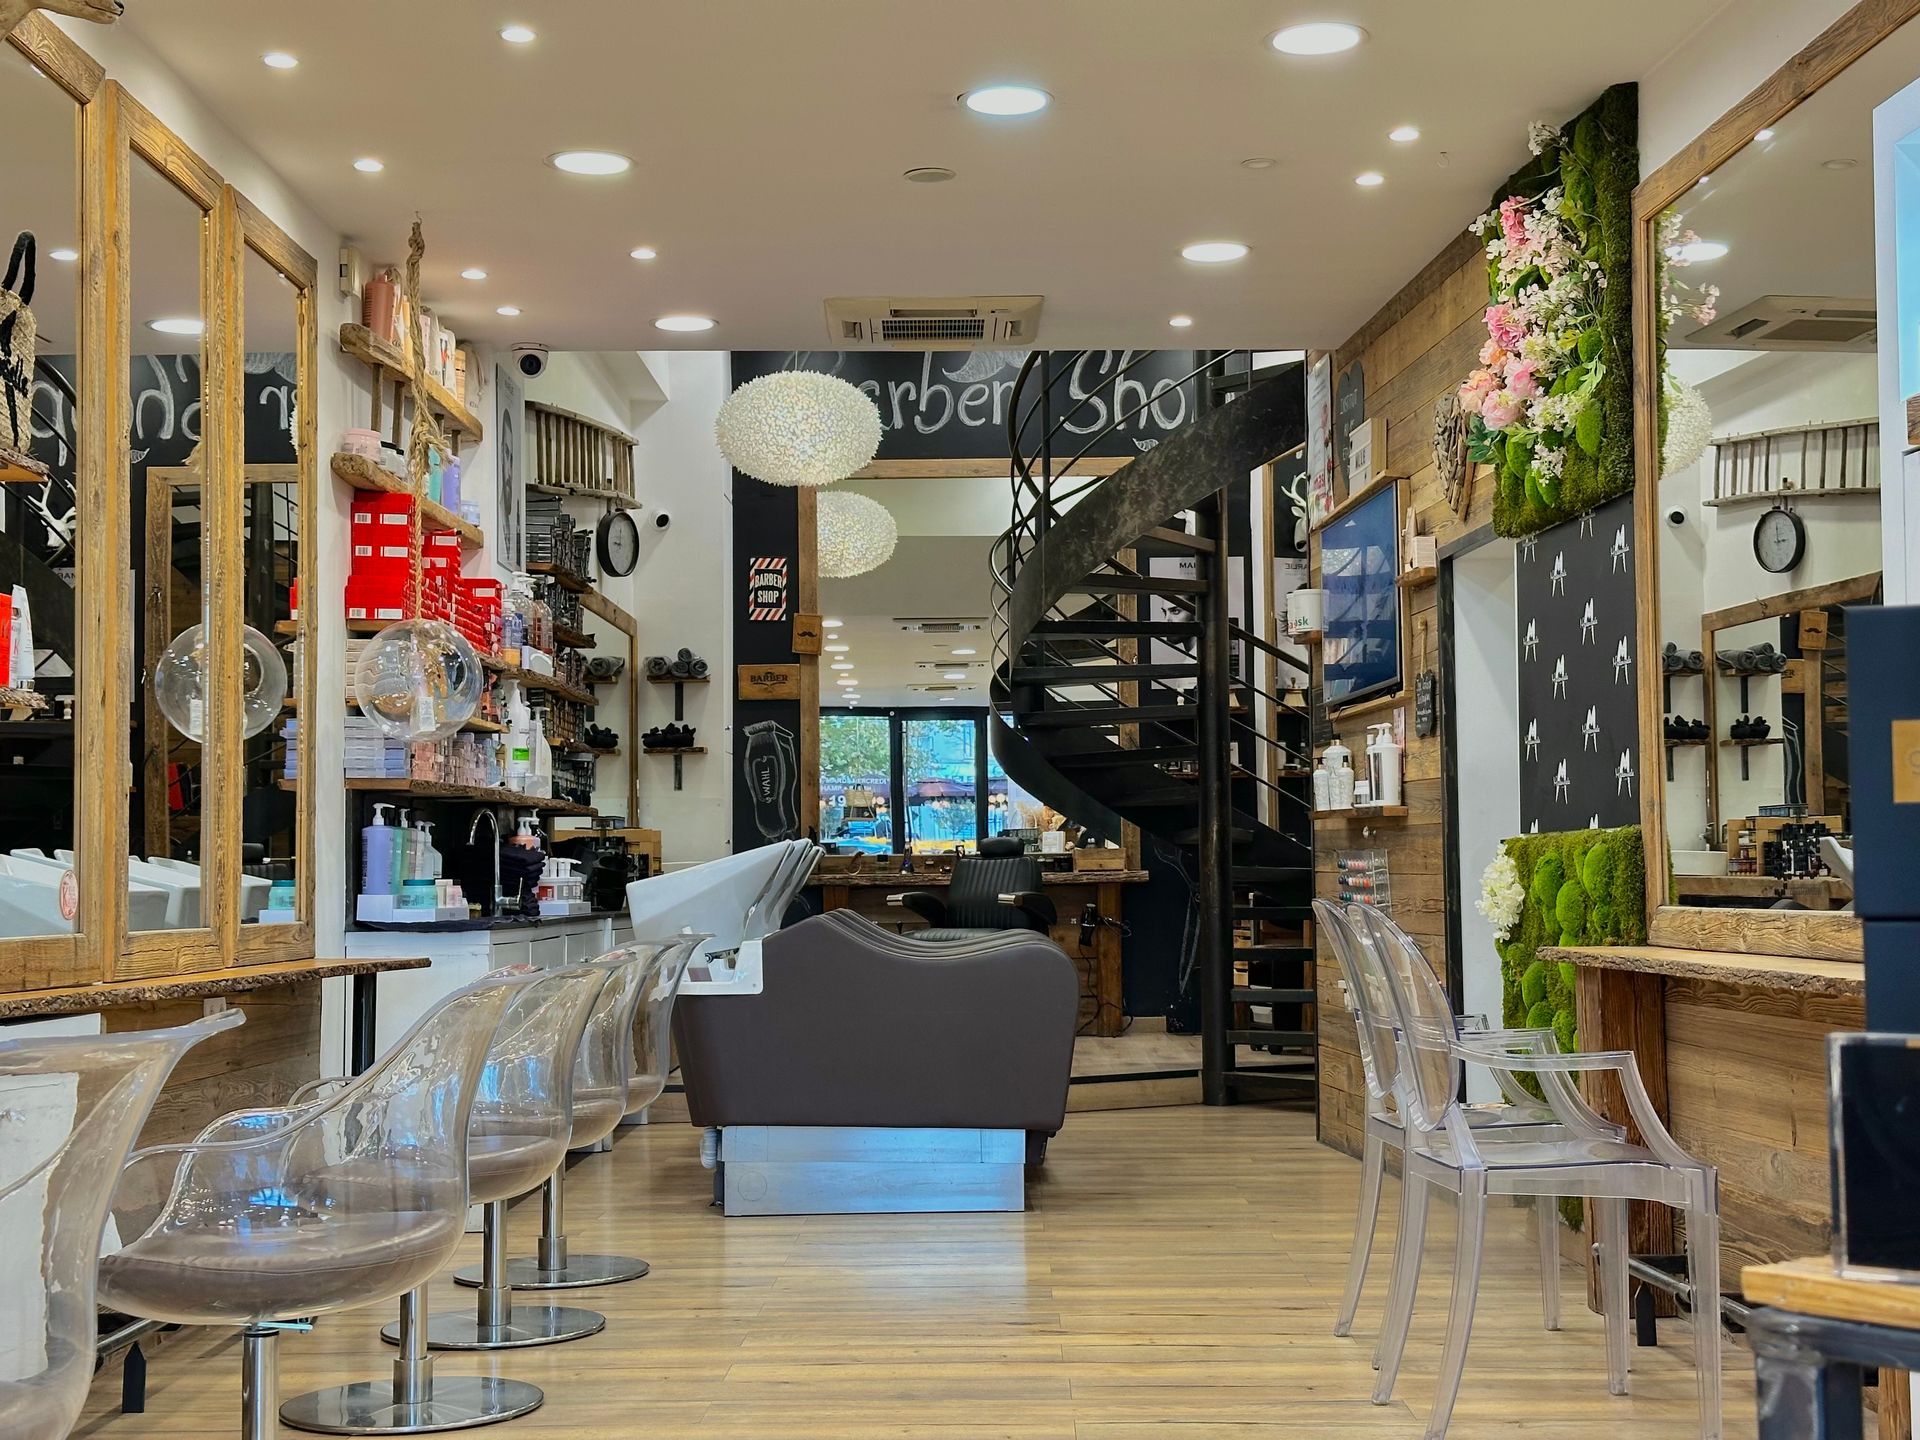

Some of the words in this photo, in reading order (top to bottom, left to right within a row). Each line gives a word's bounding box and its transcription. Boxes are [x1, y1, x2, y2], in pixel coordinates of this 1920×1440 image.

[782, 351, 1017, 434] rber
[1059, 350, 1196, 435] Sho
[754, 573, 783, 588] BARBER
[757, 590, 779, 603] SHOP
[750, 673, 789, 683] BARBER
[760, 767, 771, 796] WAHL
